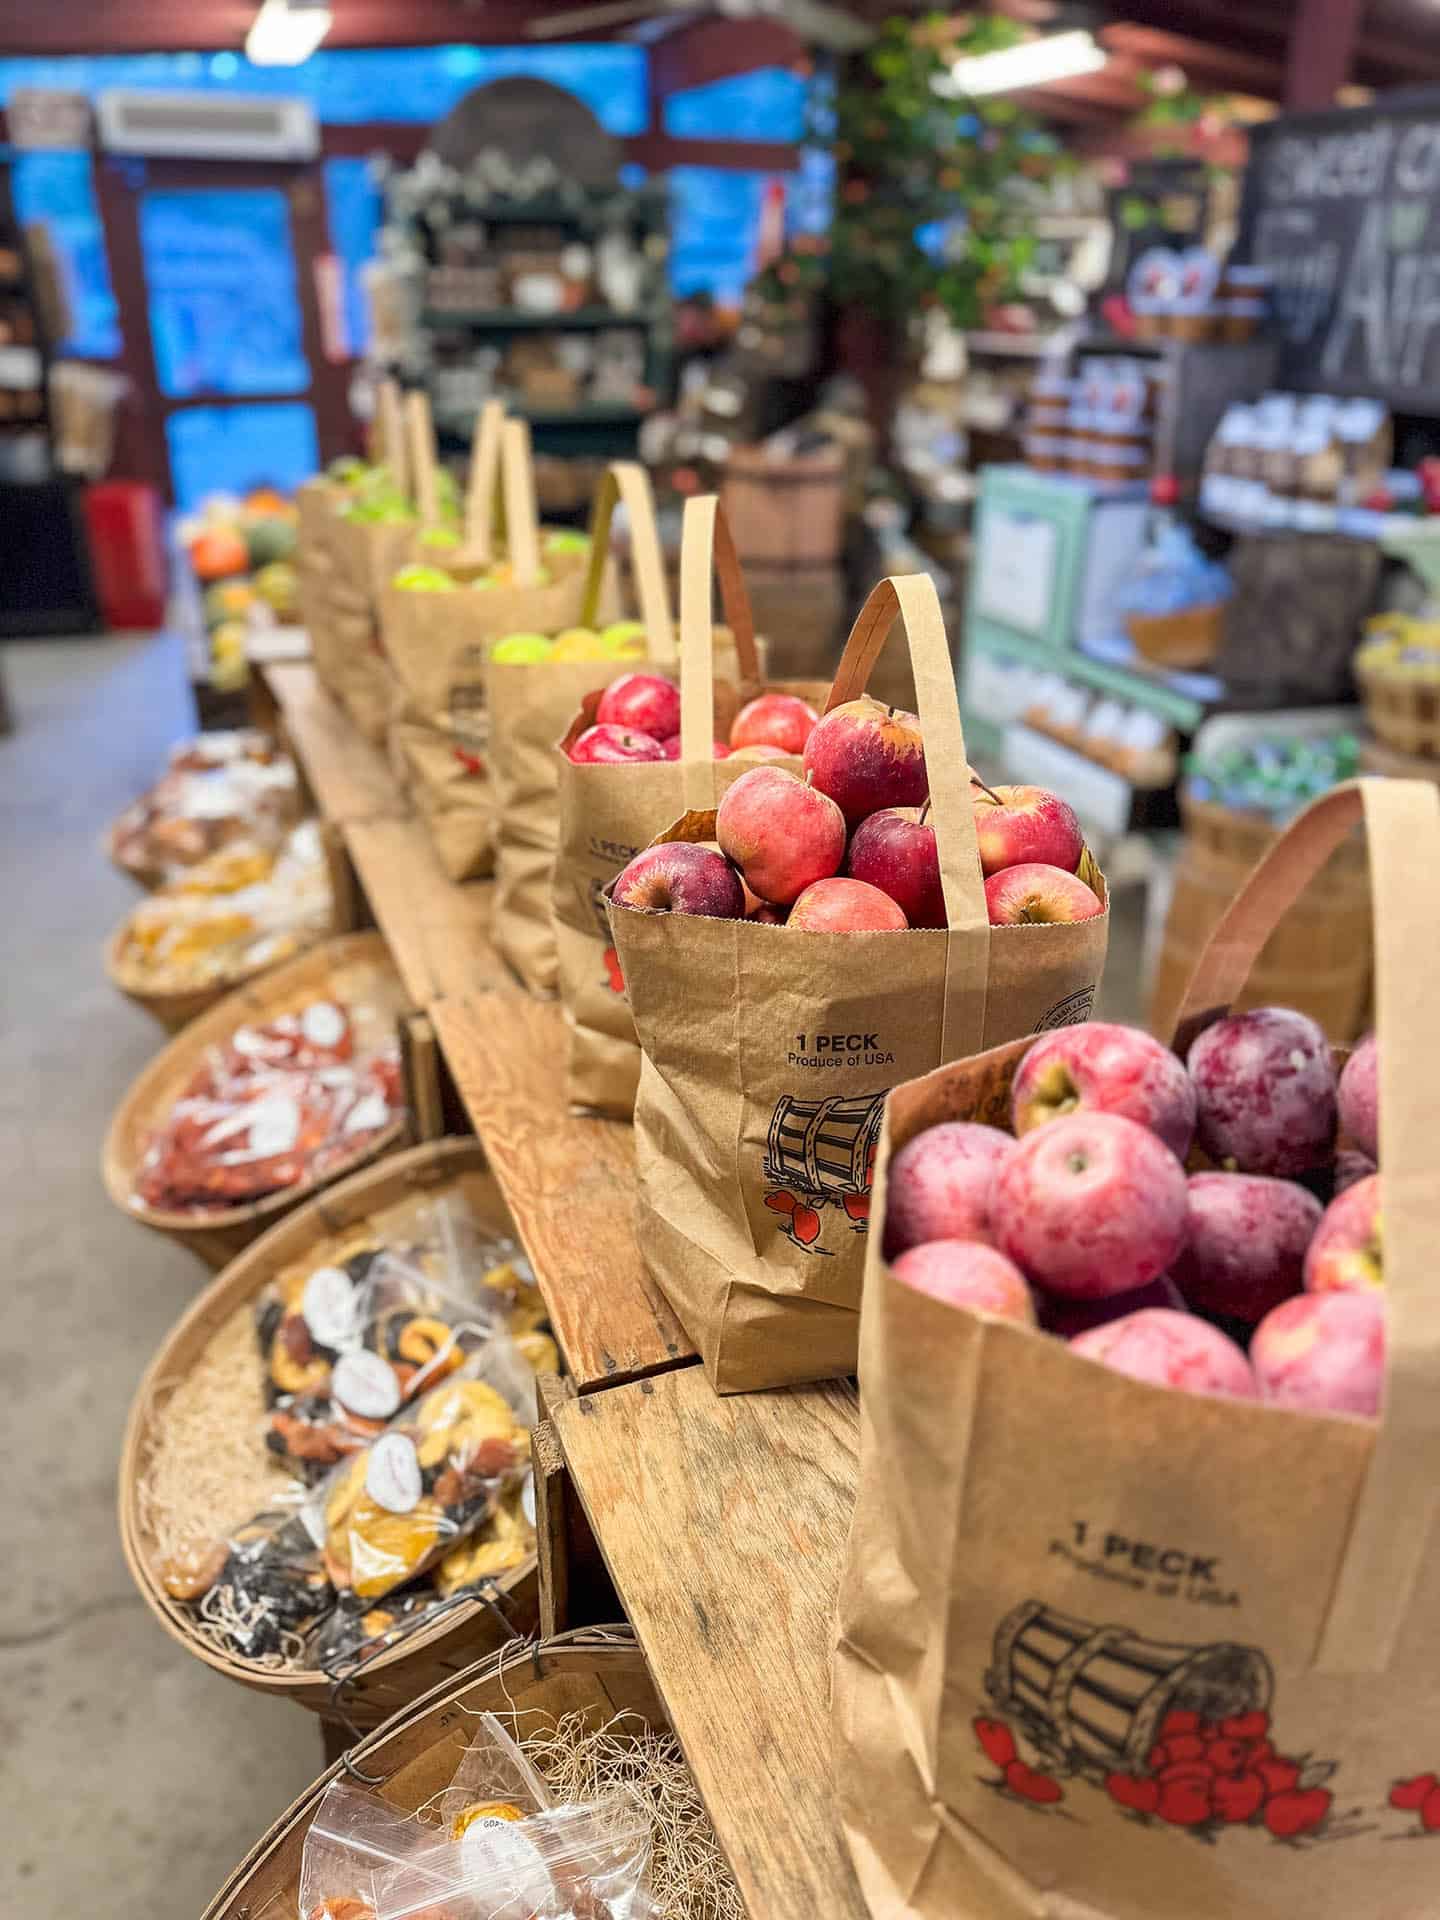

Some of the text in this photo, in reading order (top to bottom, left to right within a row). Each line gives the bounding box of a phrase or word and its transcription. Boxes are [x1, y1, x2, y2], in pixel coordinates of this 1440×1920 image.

[796, 1033, 879, 1052] 1 PECK
[788, 1052, 895, 1067] Produce of USA
[1074, 1520, 1220, 1582] 1 PECK
